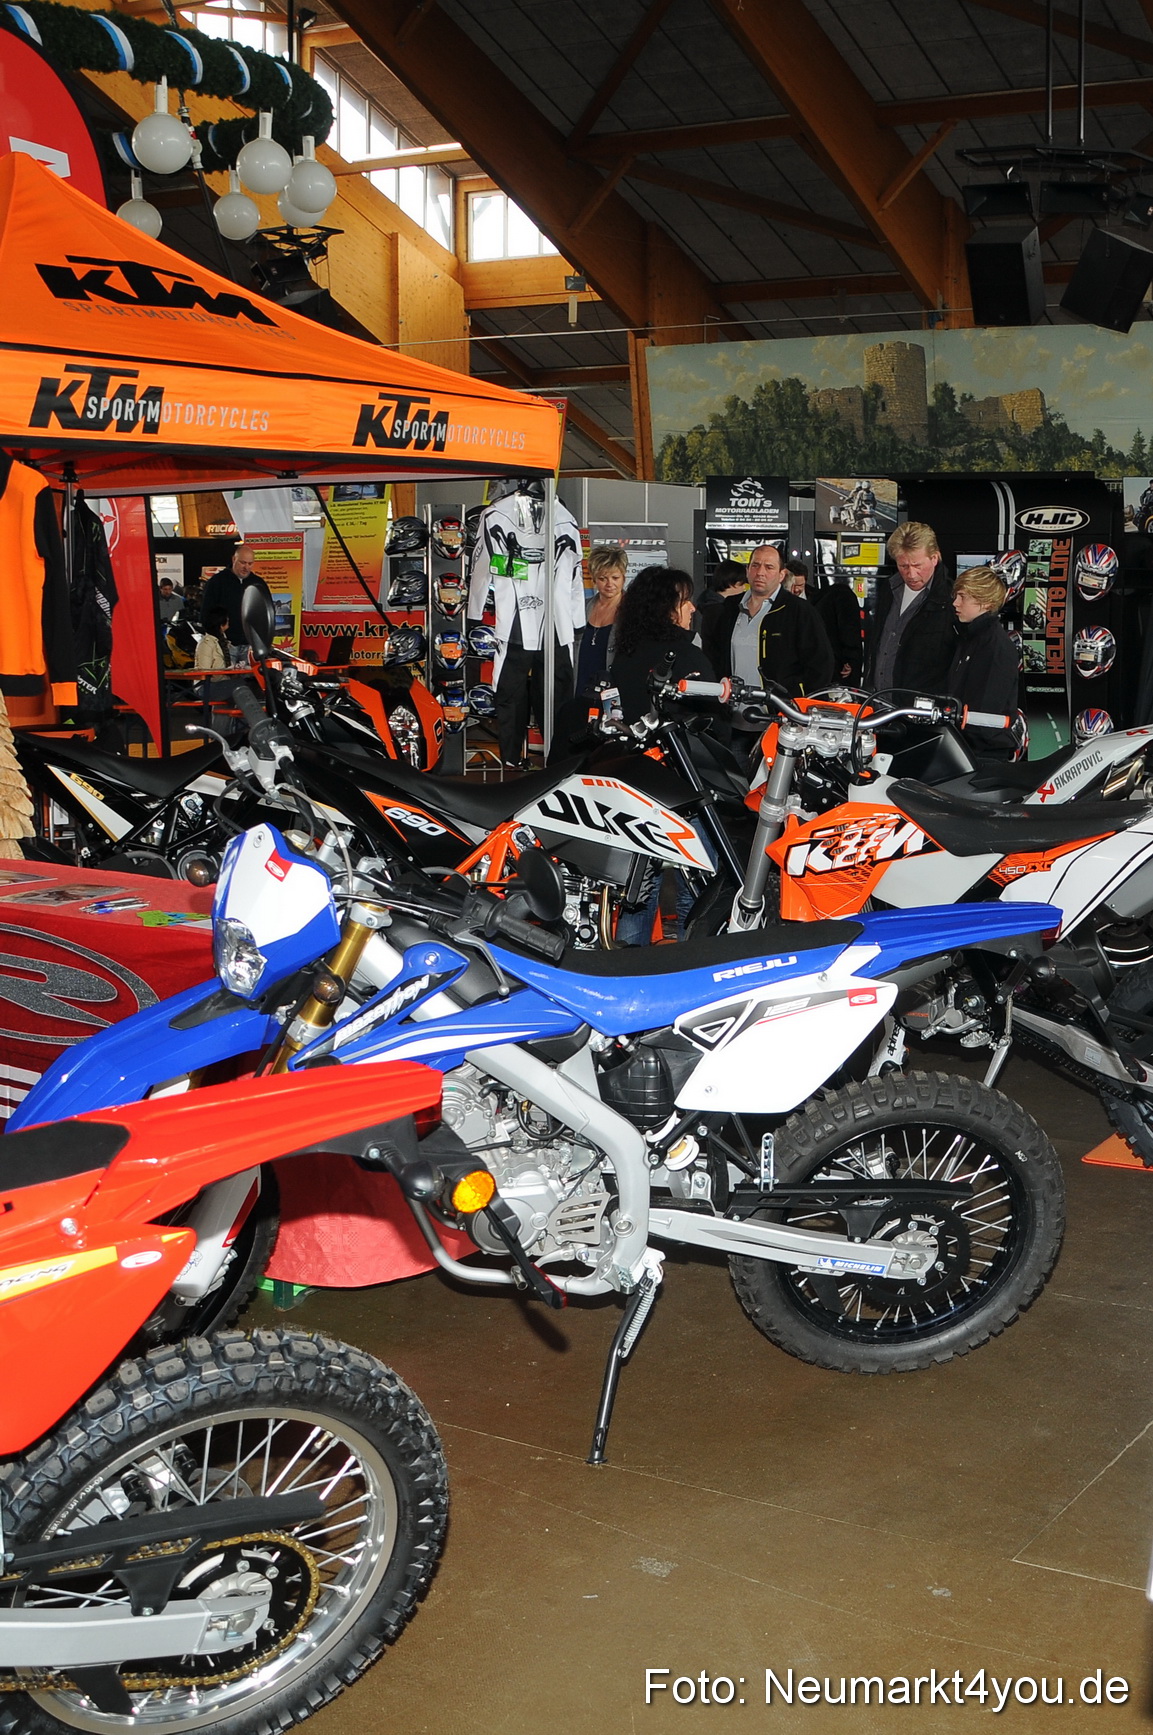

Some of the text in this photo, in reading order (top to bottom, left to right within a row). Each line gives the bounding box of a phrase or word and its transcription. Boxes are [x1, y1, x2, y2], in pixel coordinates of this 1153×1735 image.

[34, 254, 281, 328] KTM
[63, 300, 297, 341] SPORTMOTORCYCLES
[28, 363, 165, 435] KTM
[86, 395, 270, 432] SPORTMOTORCYCLES
[352, 391, 450, 452] KTM
[393, 419, 526, 450] SPORTMOTORCYCLES
[1025, 513, 1077, 525] HJC
[593, 538, 666, 547] SPYDER
[1050, 538, 1071, 582] LINE
[1046, 586, 1067, 675] HELMETS
[382, 806, 448, 837] 690
[537, 789, 682, 856] DUKE
[999, 864, 1026, 875] 450
[712, 955, 798, 983] RIEJU
[834, 1260, 883, 1273] MICHELIN
